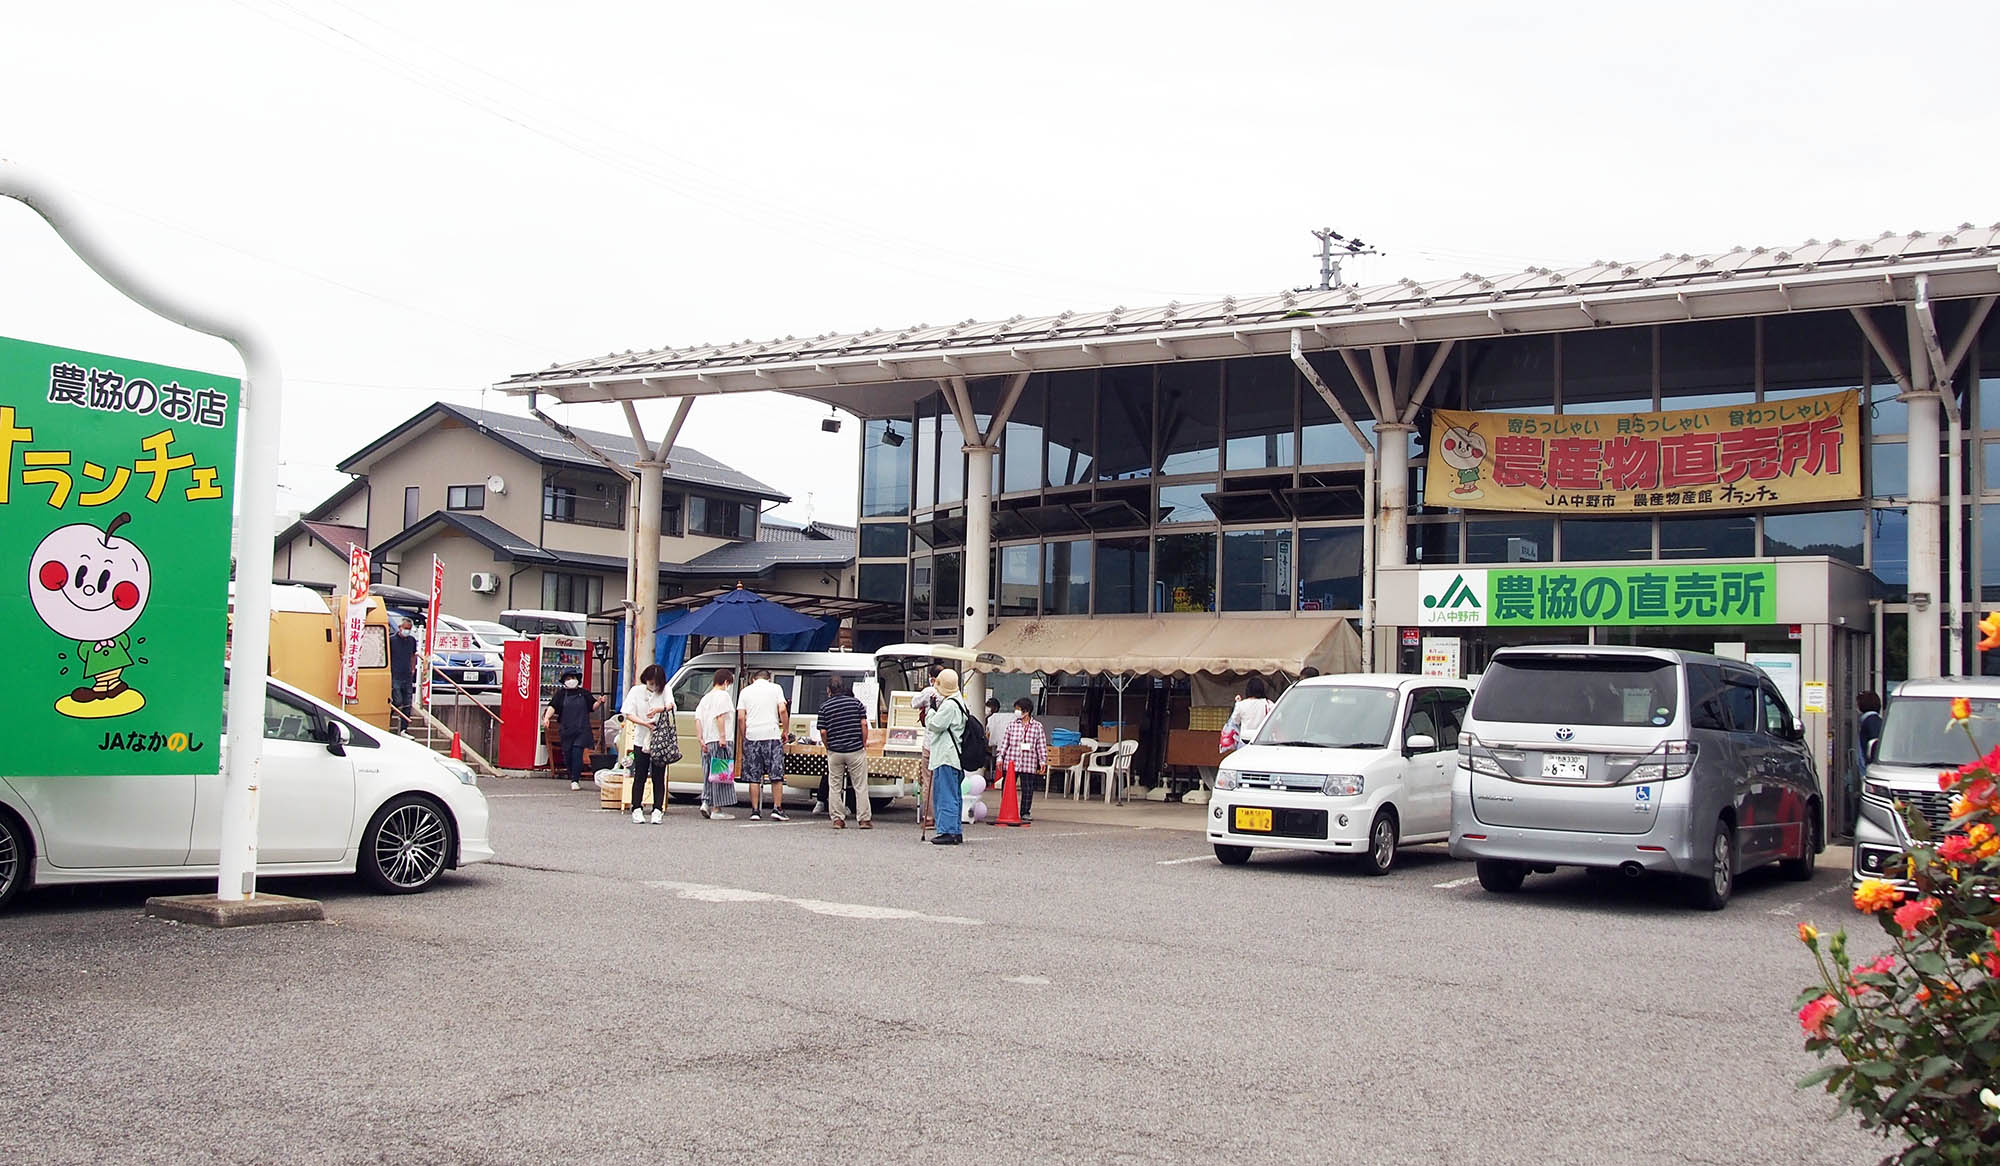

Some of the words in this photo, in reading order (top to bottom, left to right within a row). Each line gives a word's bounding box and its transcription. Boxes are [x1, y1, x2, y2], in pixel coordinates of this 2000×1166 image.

[49, 363, 227, 428] 農協のお店
[1508, 418, 1600, 435] 寄らっしゃい
[1617, 414, 1710, 434] 見らっしゃい
[1729, 401, 1831, 427] 買わっしゃい
[1491, 415, 1844, 491] 農産物直売所
[1545, 494, 1616, 508] JA中野市
[1633, 489, 1713, 507] 農産物産館
[1719, 483, 1779, 505] オランチェ
[1495, 571, 1766, 620] 農協の直売所
[1428, 611, 1480, 623] JA中野市
[519, 651, 531, 700] Coca-Cola
[98, 731, 204, 752] JAなかのし
